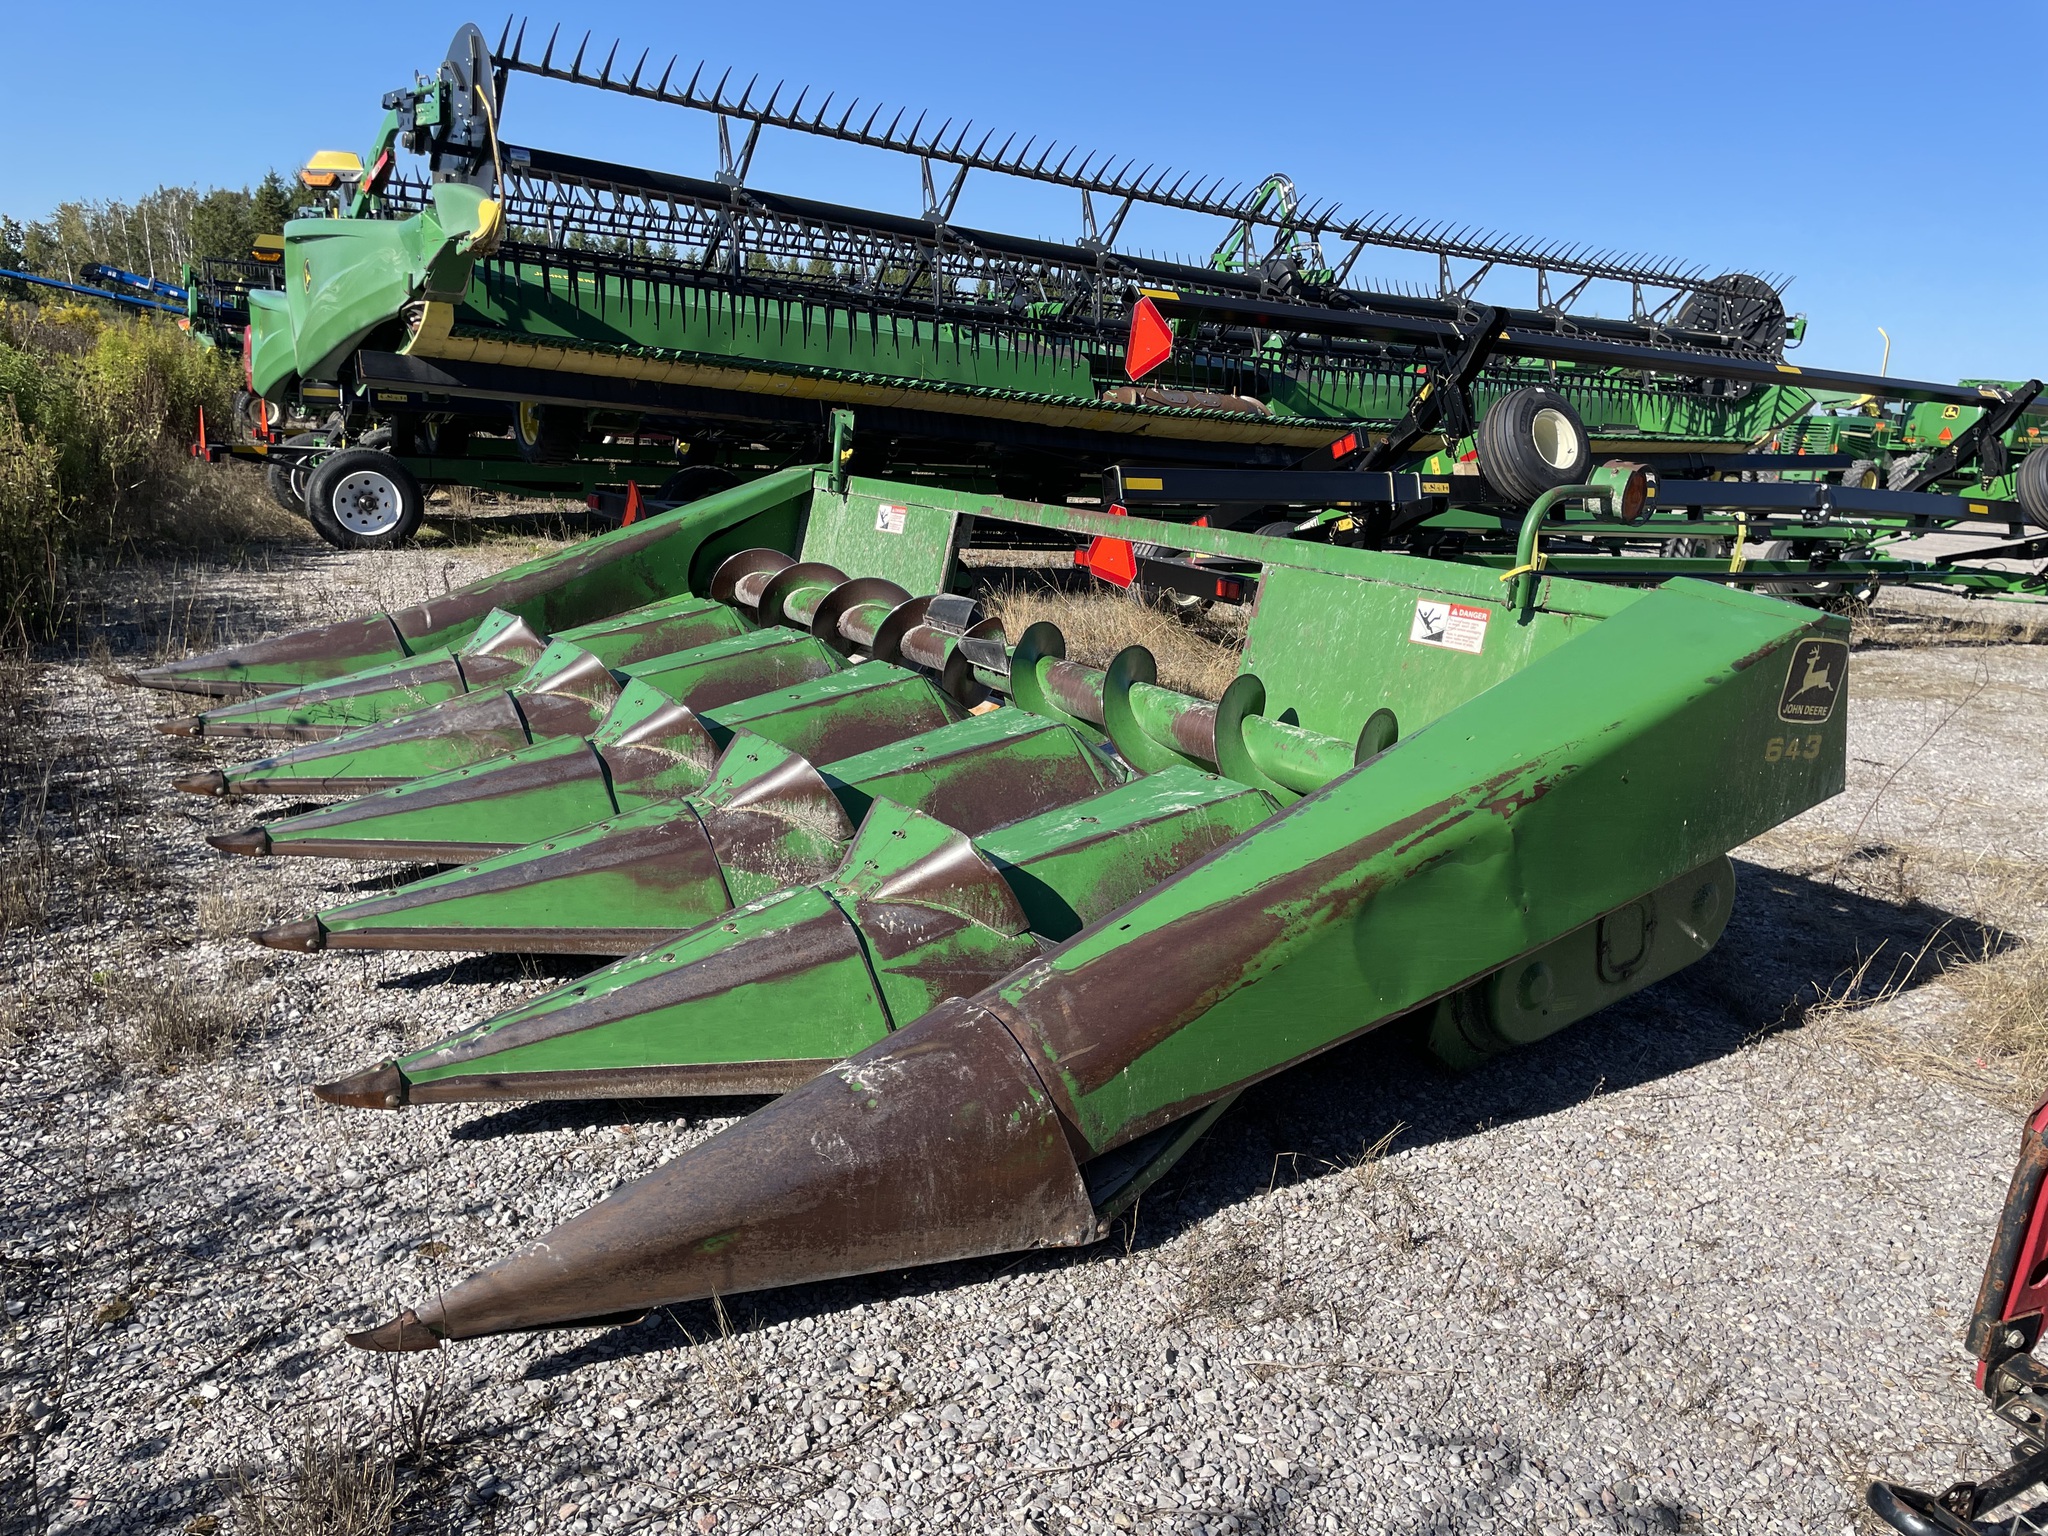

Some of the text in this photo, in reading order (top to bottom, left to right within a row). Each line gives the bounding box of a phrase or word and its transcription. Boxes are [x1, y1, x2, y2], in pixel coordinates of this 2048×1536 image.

[1459, 608, 1488, 620] DANGER
[1782, 703, 1829, 716] JOHN DEERE
[1764, 734, 1823, 762] 643
